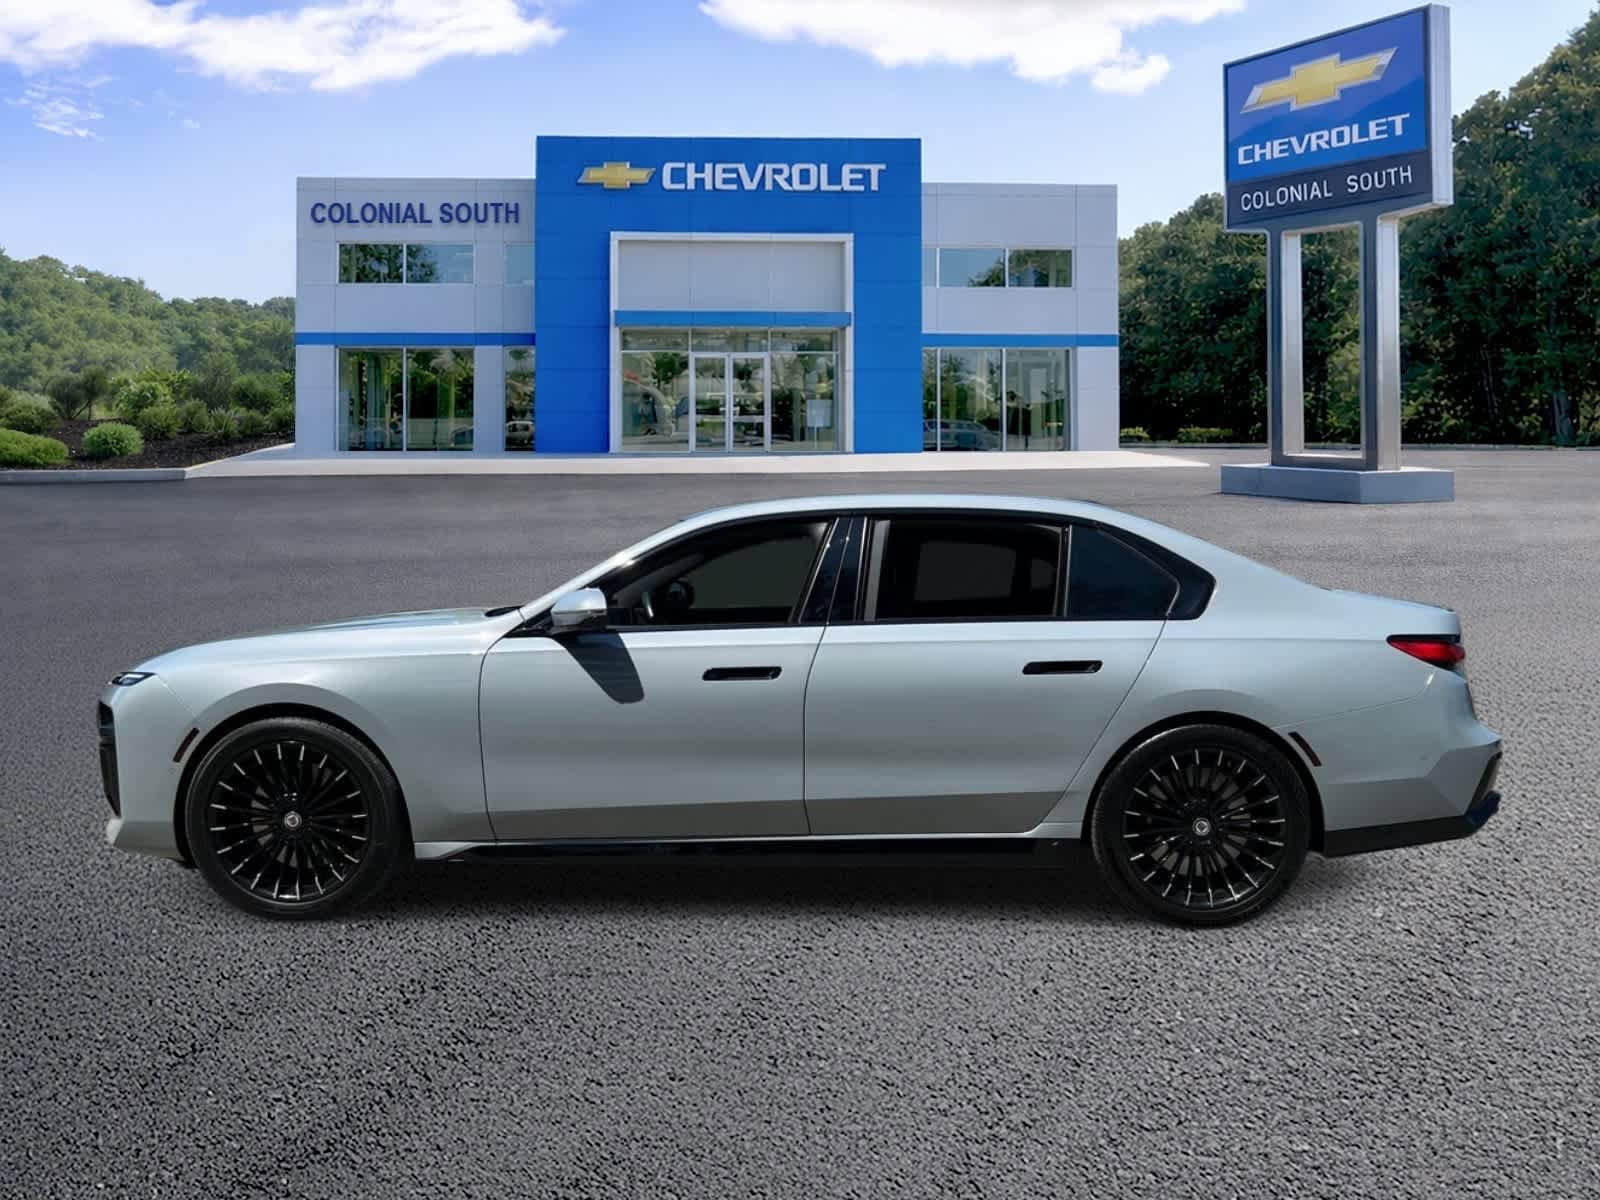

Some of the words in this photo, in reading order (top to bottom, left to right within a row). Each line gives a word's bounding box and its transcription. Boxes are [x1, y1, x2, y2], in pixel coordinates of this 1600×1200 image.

[1237, 112, 1411, 166] CHEVROLET
[661, 161, 887, 193] CHEVROLET
[1240, 179, 1333, 212] COLONIAL
[1346, 165, 1412, 194] SOUTH
[310, 202, 433, 225] COLONIAL
[439, 202, 521, 225] SOUTH
